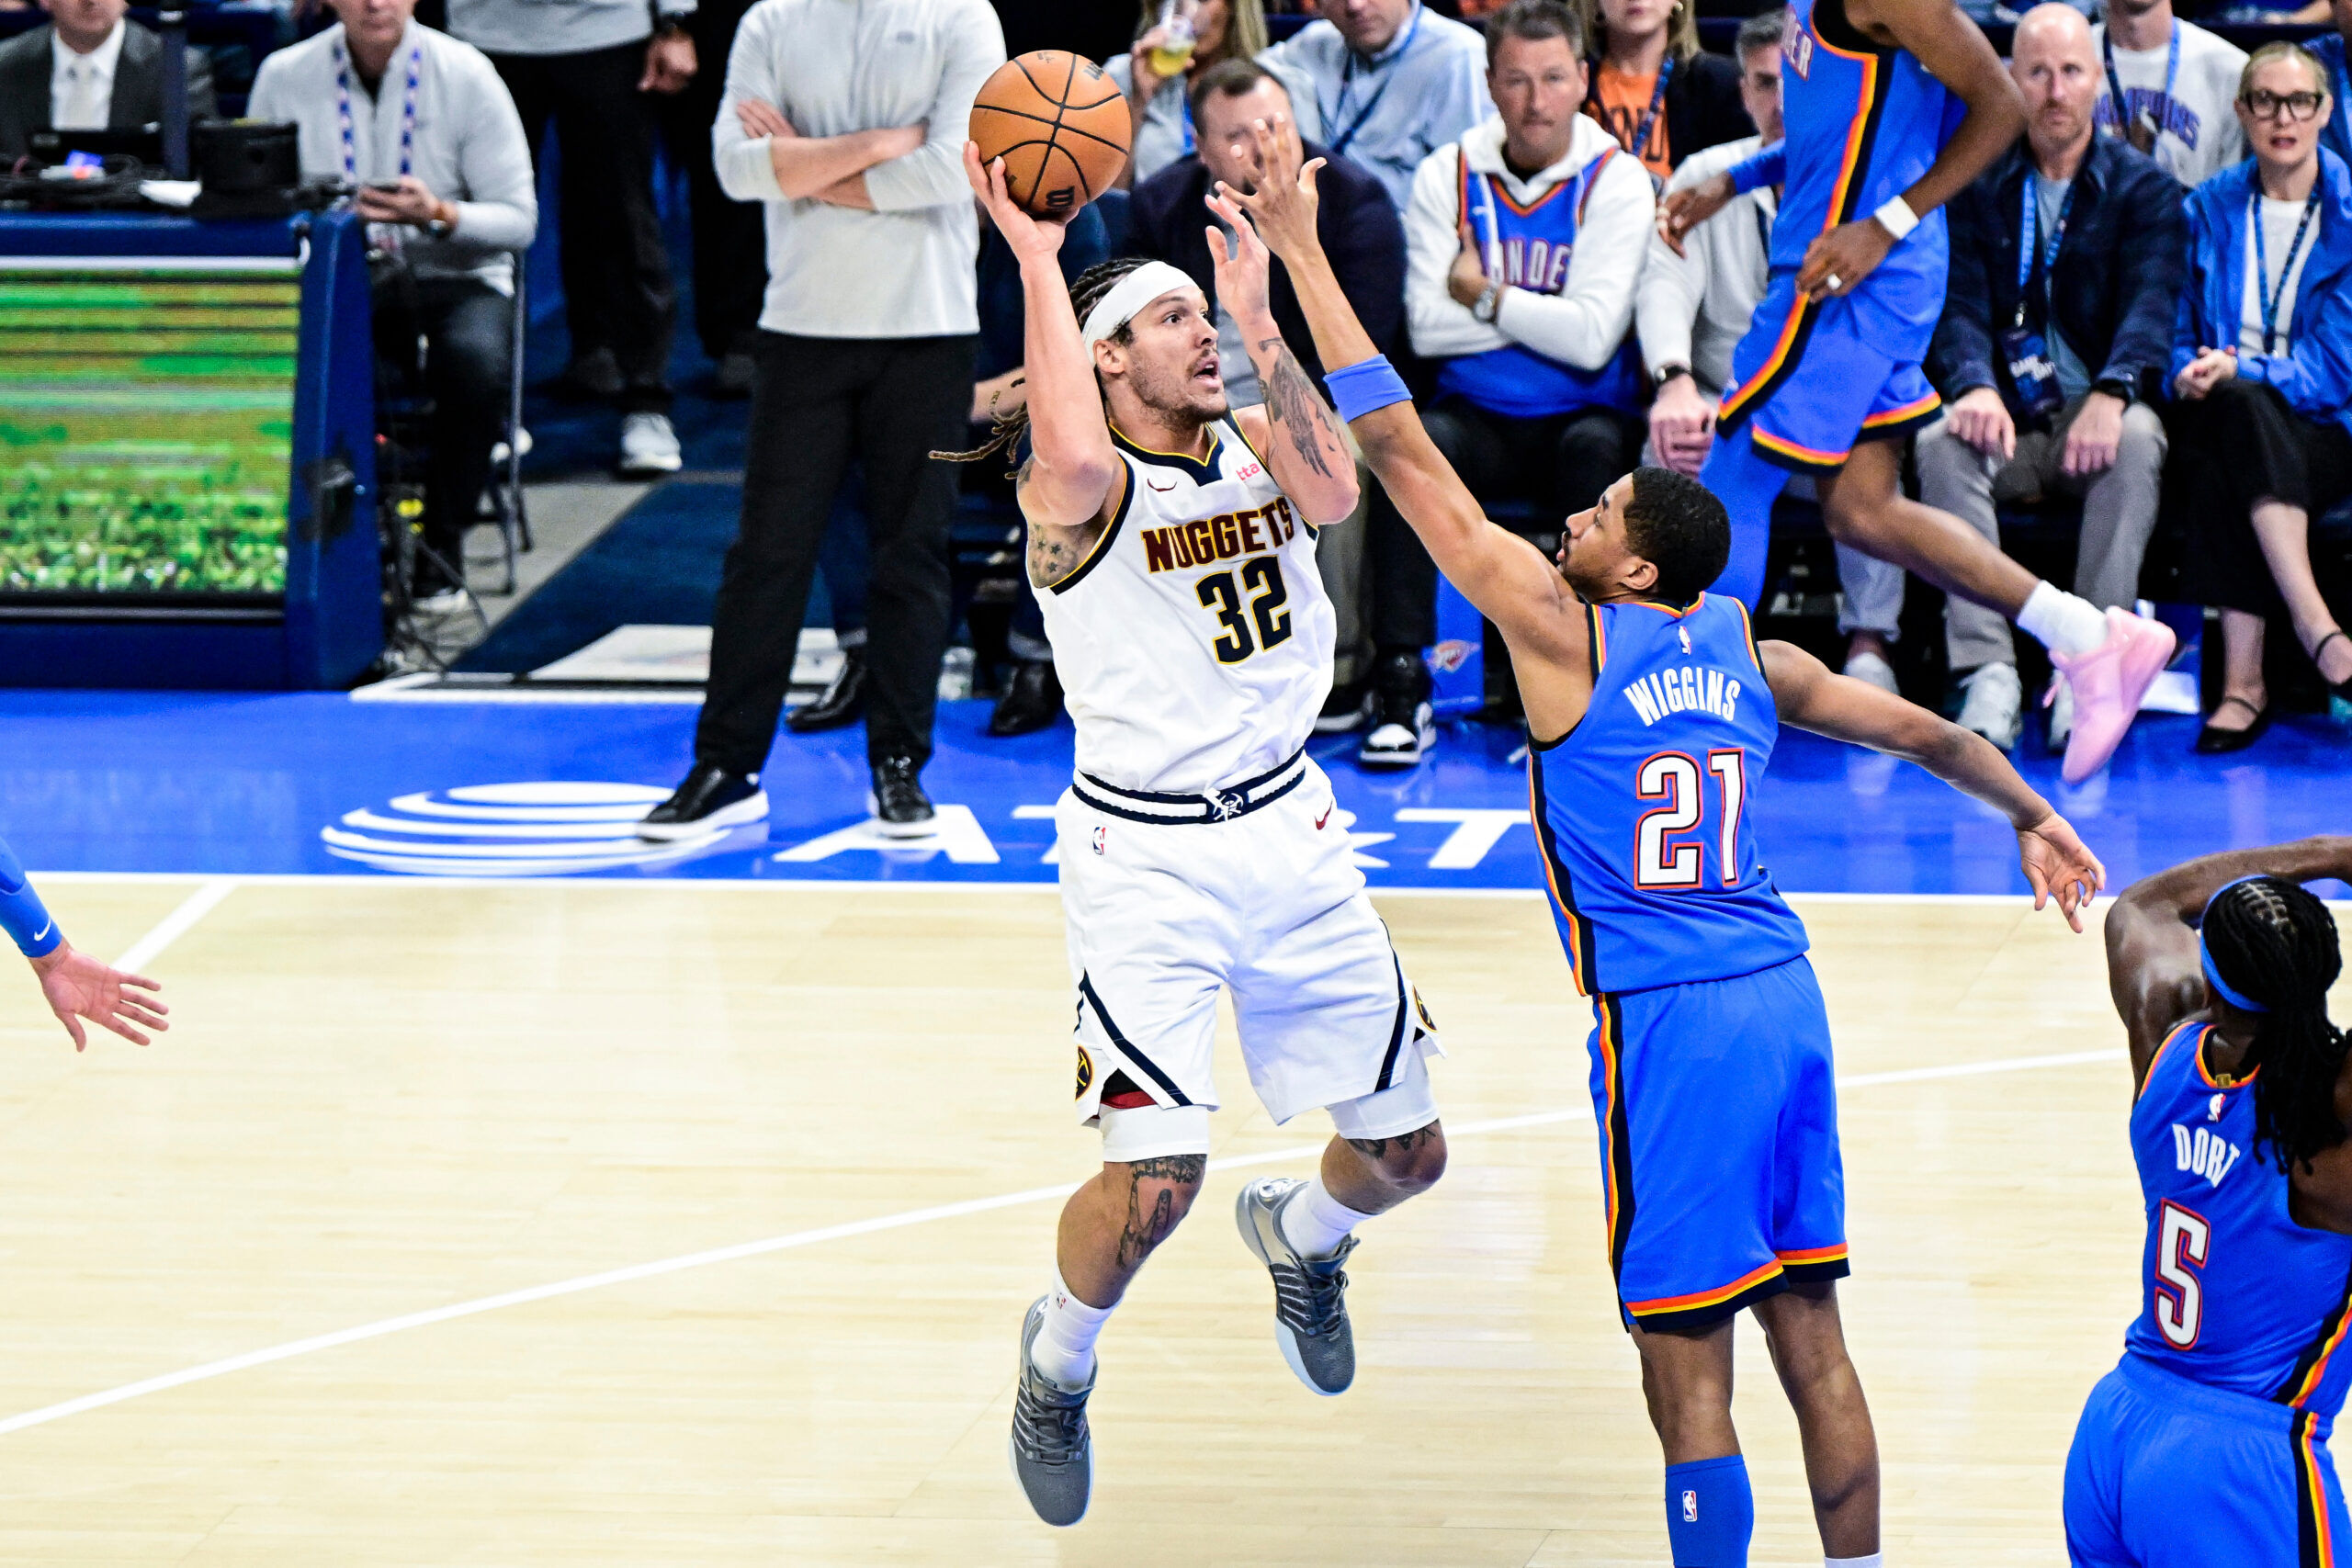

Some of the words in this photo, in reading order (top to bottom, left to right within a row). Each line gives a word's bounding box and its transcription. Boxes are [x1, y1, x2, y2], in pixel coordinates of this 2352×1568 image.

[1140, 495, 1295, 574] NUGGETS
[1193, 554, 1292, 665] 32
[1623, 666, 1741, 727] WIGGINS
[1634, 747, 1745, 890] 21
[2172, 1122, 2240, 1188] DORT
[2154, 1197, 2211, 1351] 5
